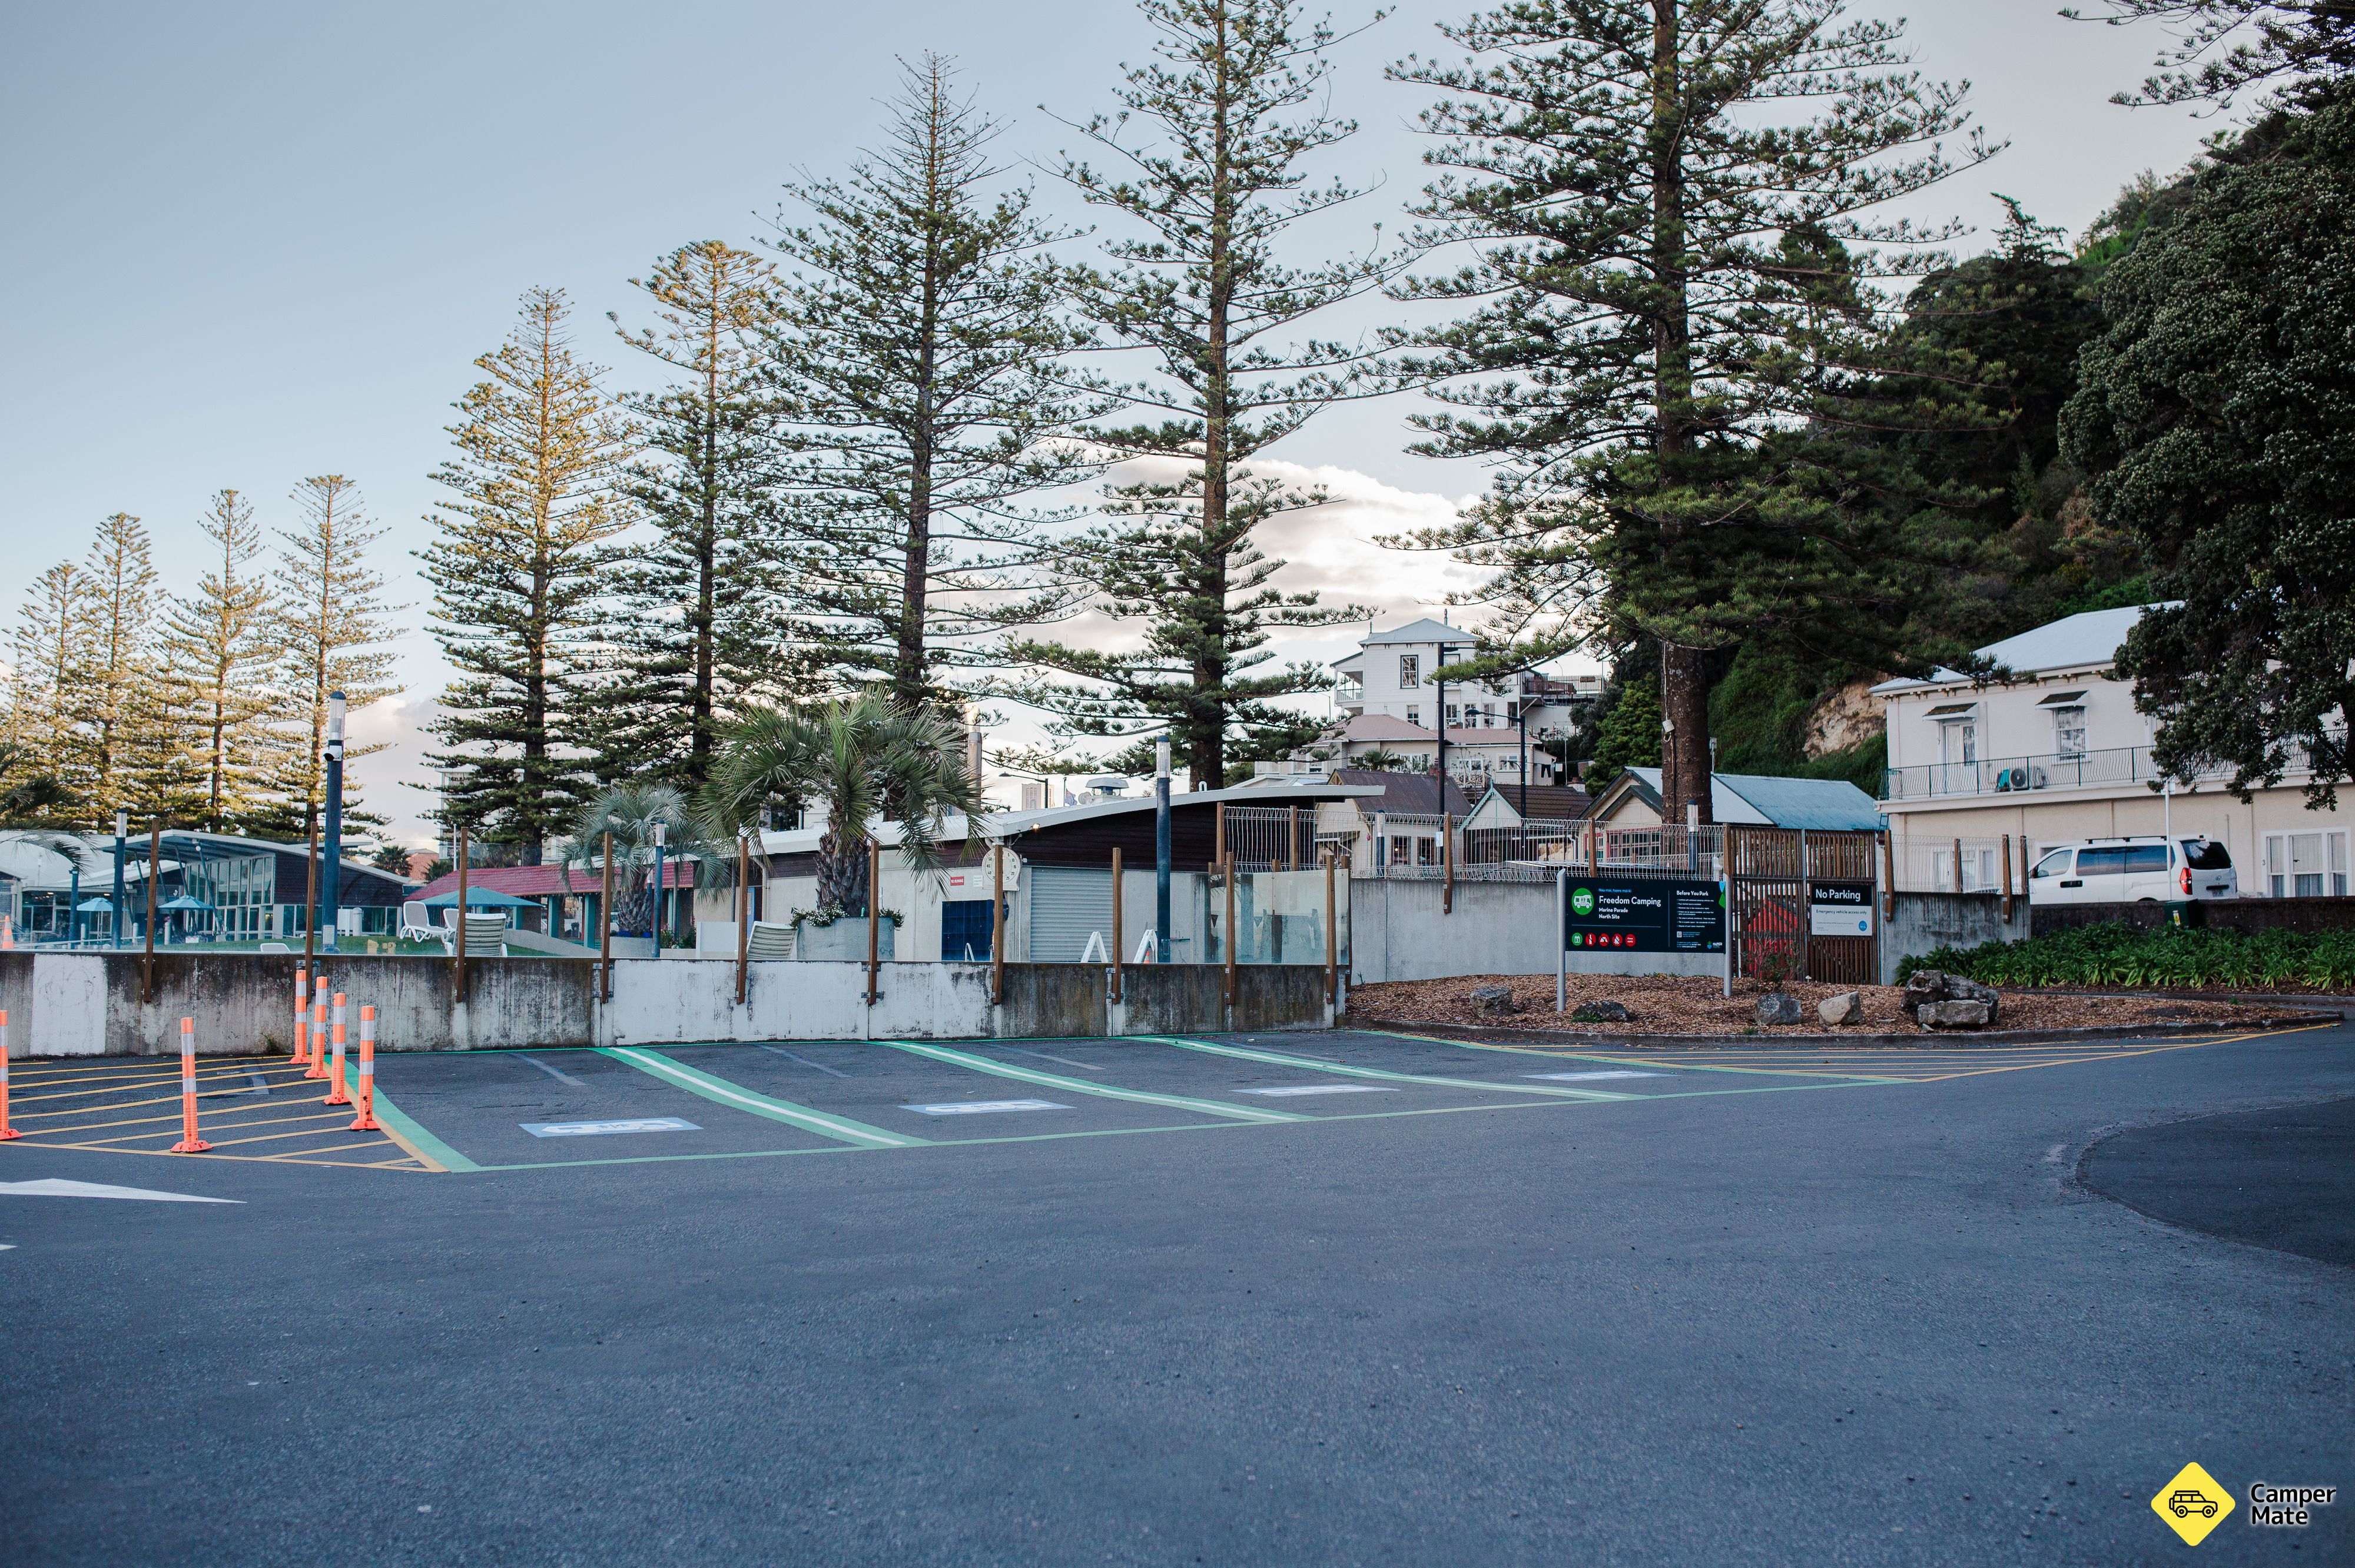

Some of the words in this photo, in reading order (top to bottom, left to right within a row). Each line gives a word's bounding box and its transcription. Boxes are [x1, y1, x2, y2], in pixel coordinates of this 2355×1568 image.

[1599, 896, 1630, 904] Freedom
[1631, 896, 1661, 907] Camping
[1816, 889, 1827, 898] No
[1829, 889, 1860, 902] Parking
